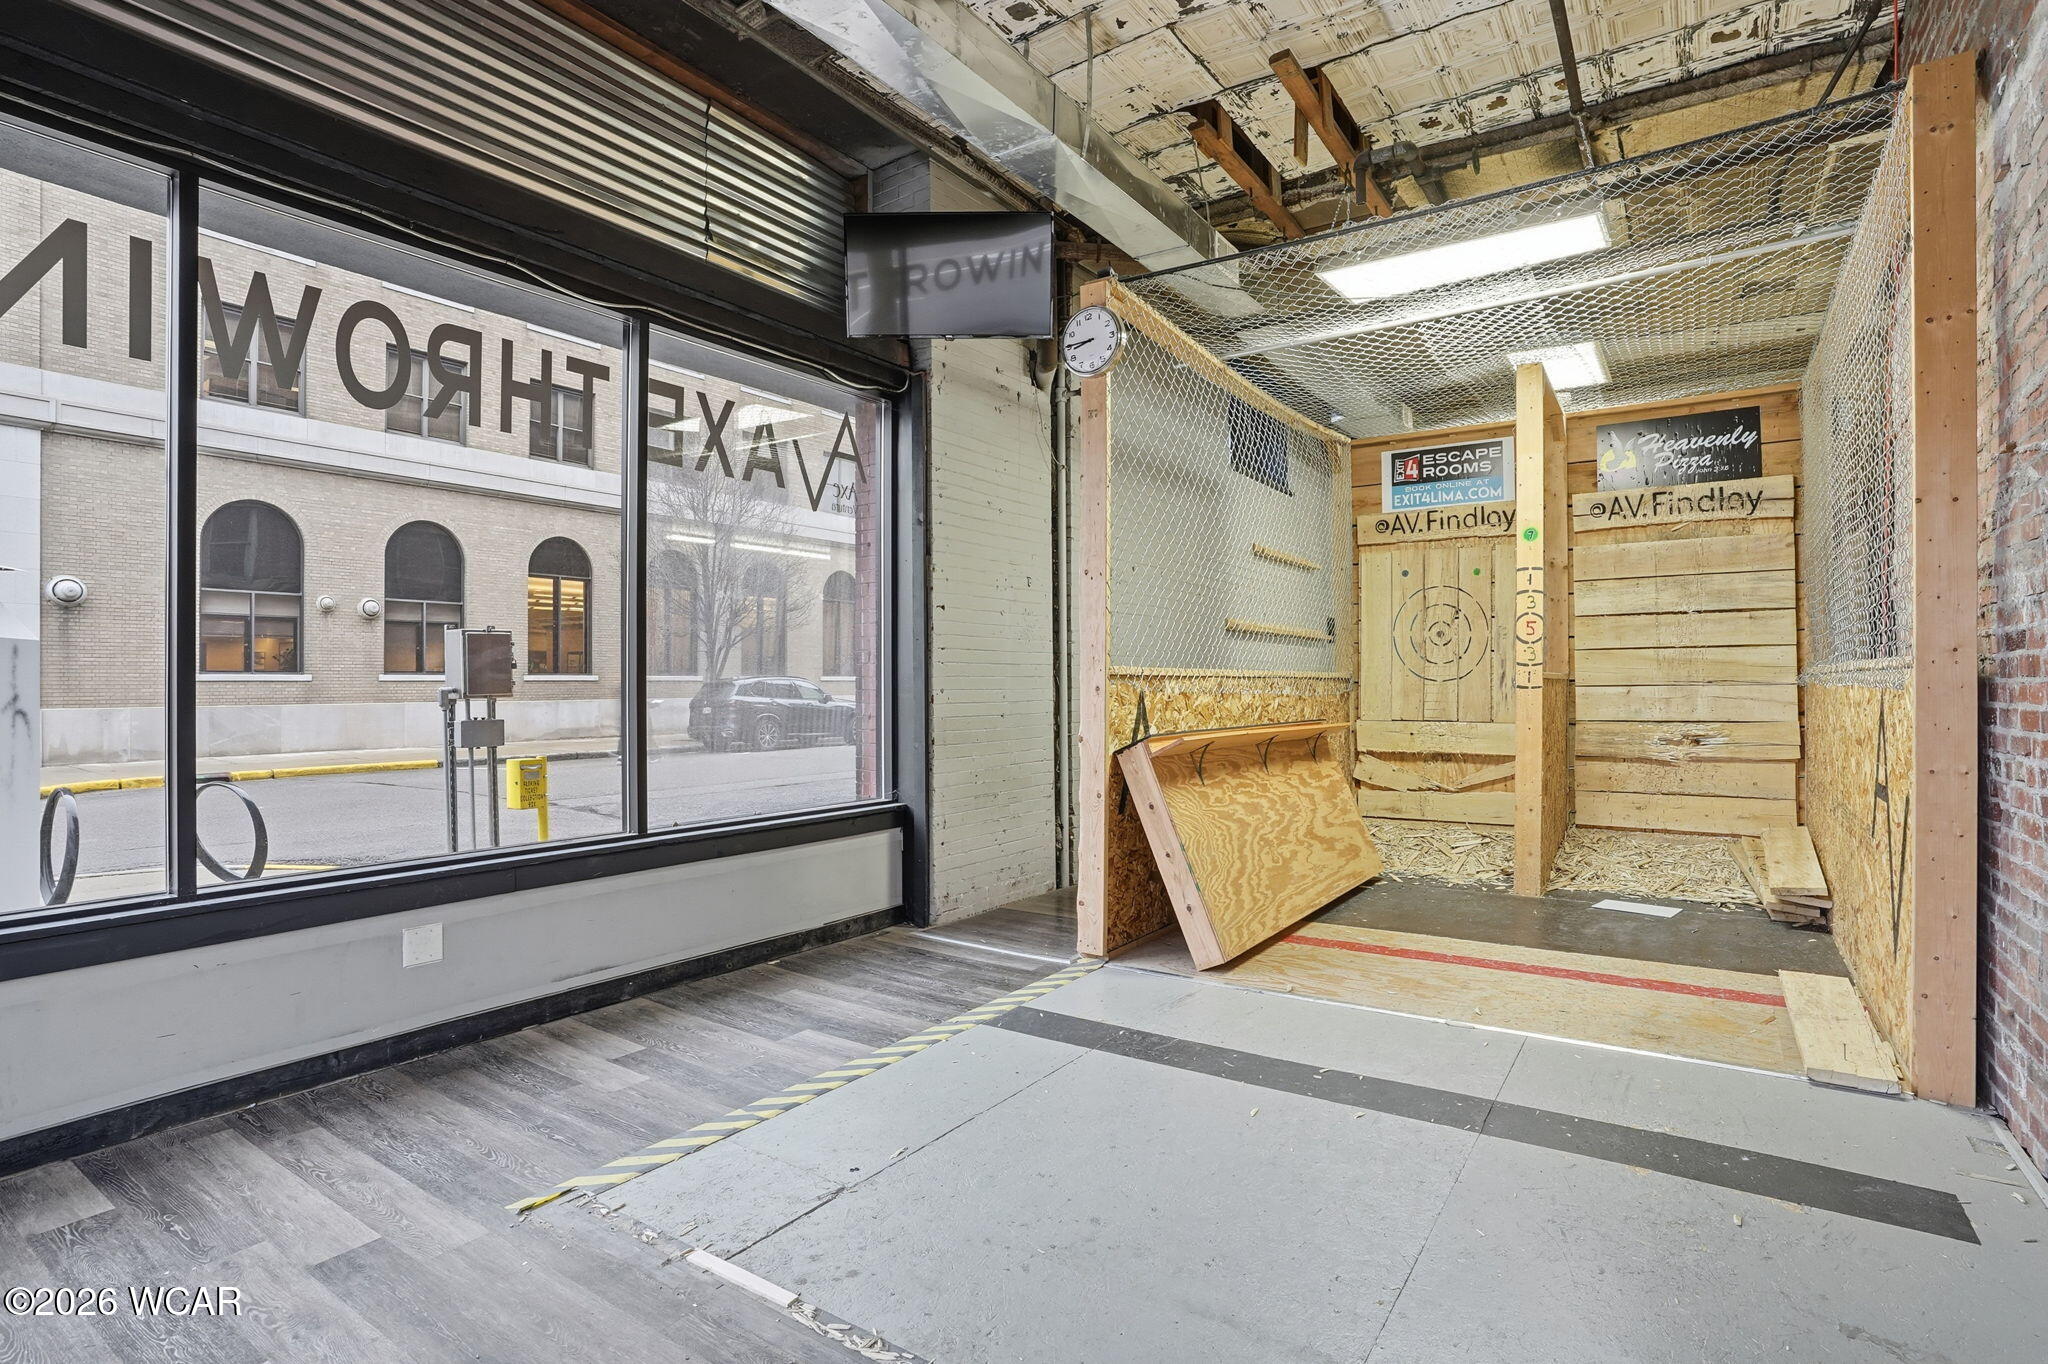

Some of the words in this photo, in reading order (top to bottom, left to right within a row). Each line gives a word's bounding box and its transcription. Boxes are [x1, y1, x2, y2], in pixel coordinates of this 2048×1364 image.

[1076, 319, 1082, 327] 11
[1085, 313, 1093, 321] 12
[1104, 319, 1111, 328] 2
[1069, 331, 1076, 339] 10
[1109, 331, 1115, 339] 3
[1070, 354, 1077, 362] 8
[1100, 355, 1106, 363] 5
[1079, 361, 1084, 369] 7
[1089, 361, 1095, 369] 6
[1637, 425, 1759, 455] Heavenly
[1422, 446, 1502, 466] ESCAPE
[1654, 451, 1714, 475] Pizza
[1395, 460, 1405, 480] EXIT
[1405, 459, 1419, 479] 4
[1422, 461, 1492, 478] ROOMS
[1404, 485, 1432, 493] BOOK
[1435, 480, 1472, 489] ONLINE
[1475, 478, 1490, 486] AT
[1394, 486, 1502, 507] EXIT4LIMA.COM
[1527, 574, 1532, 585] 1
[1527, 595, 1537, 609] 3
[1526, 620, 1537, 636] 5
[1527, 647, 1537, 661] 3
